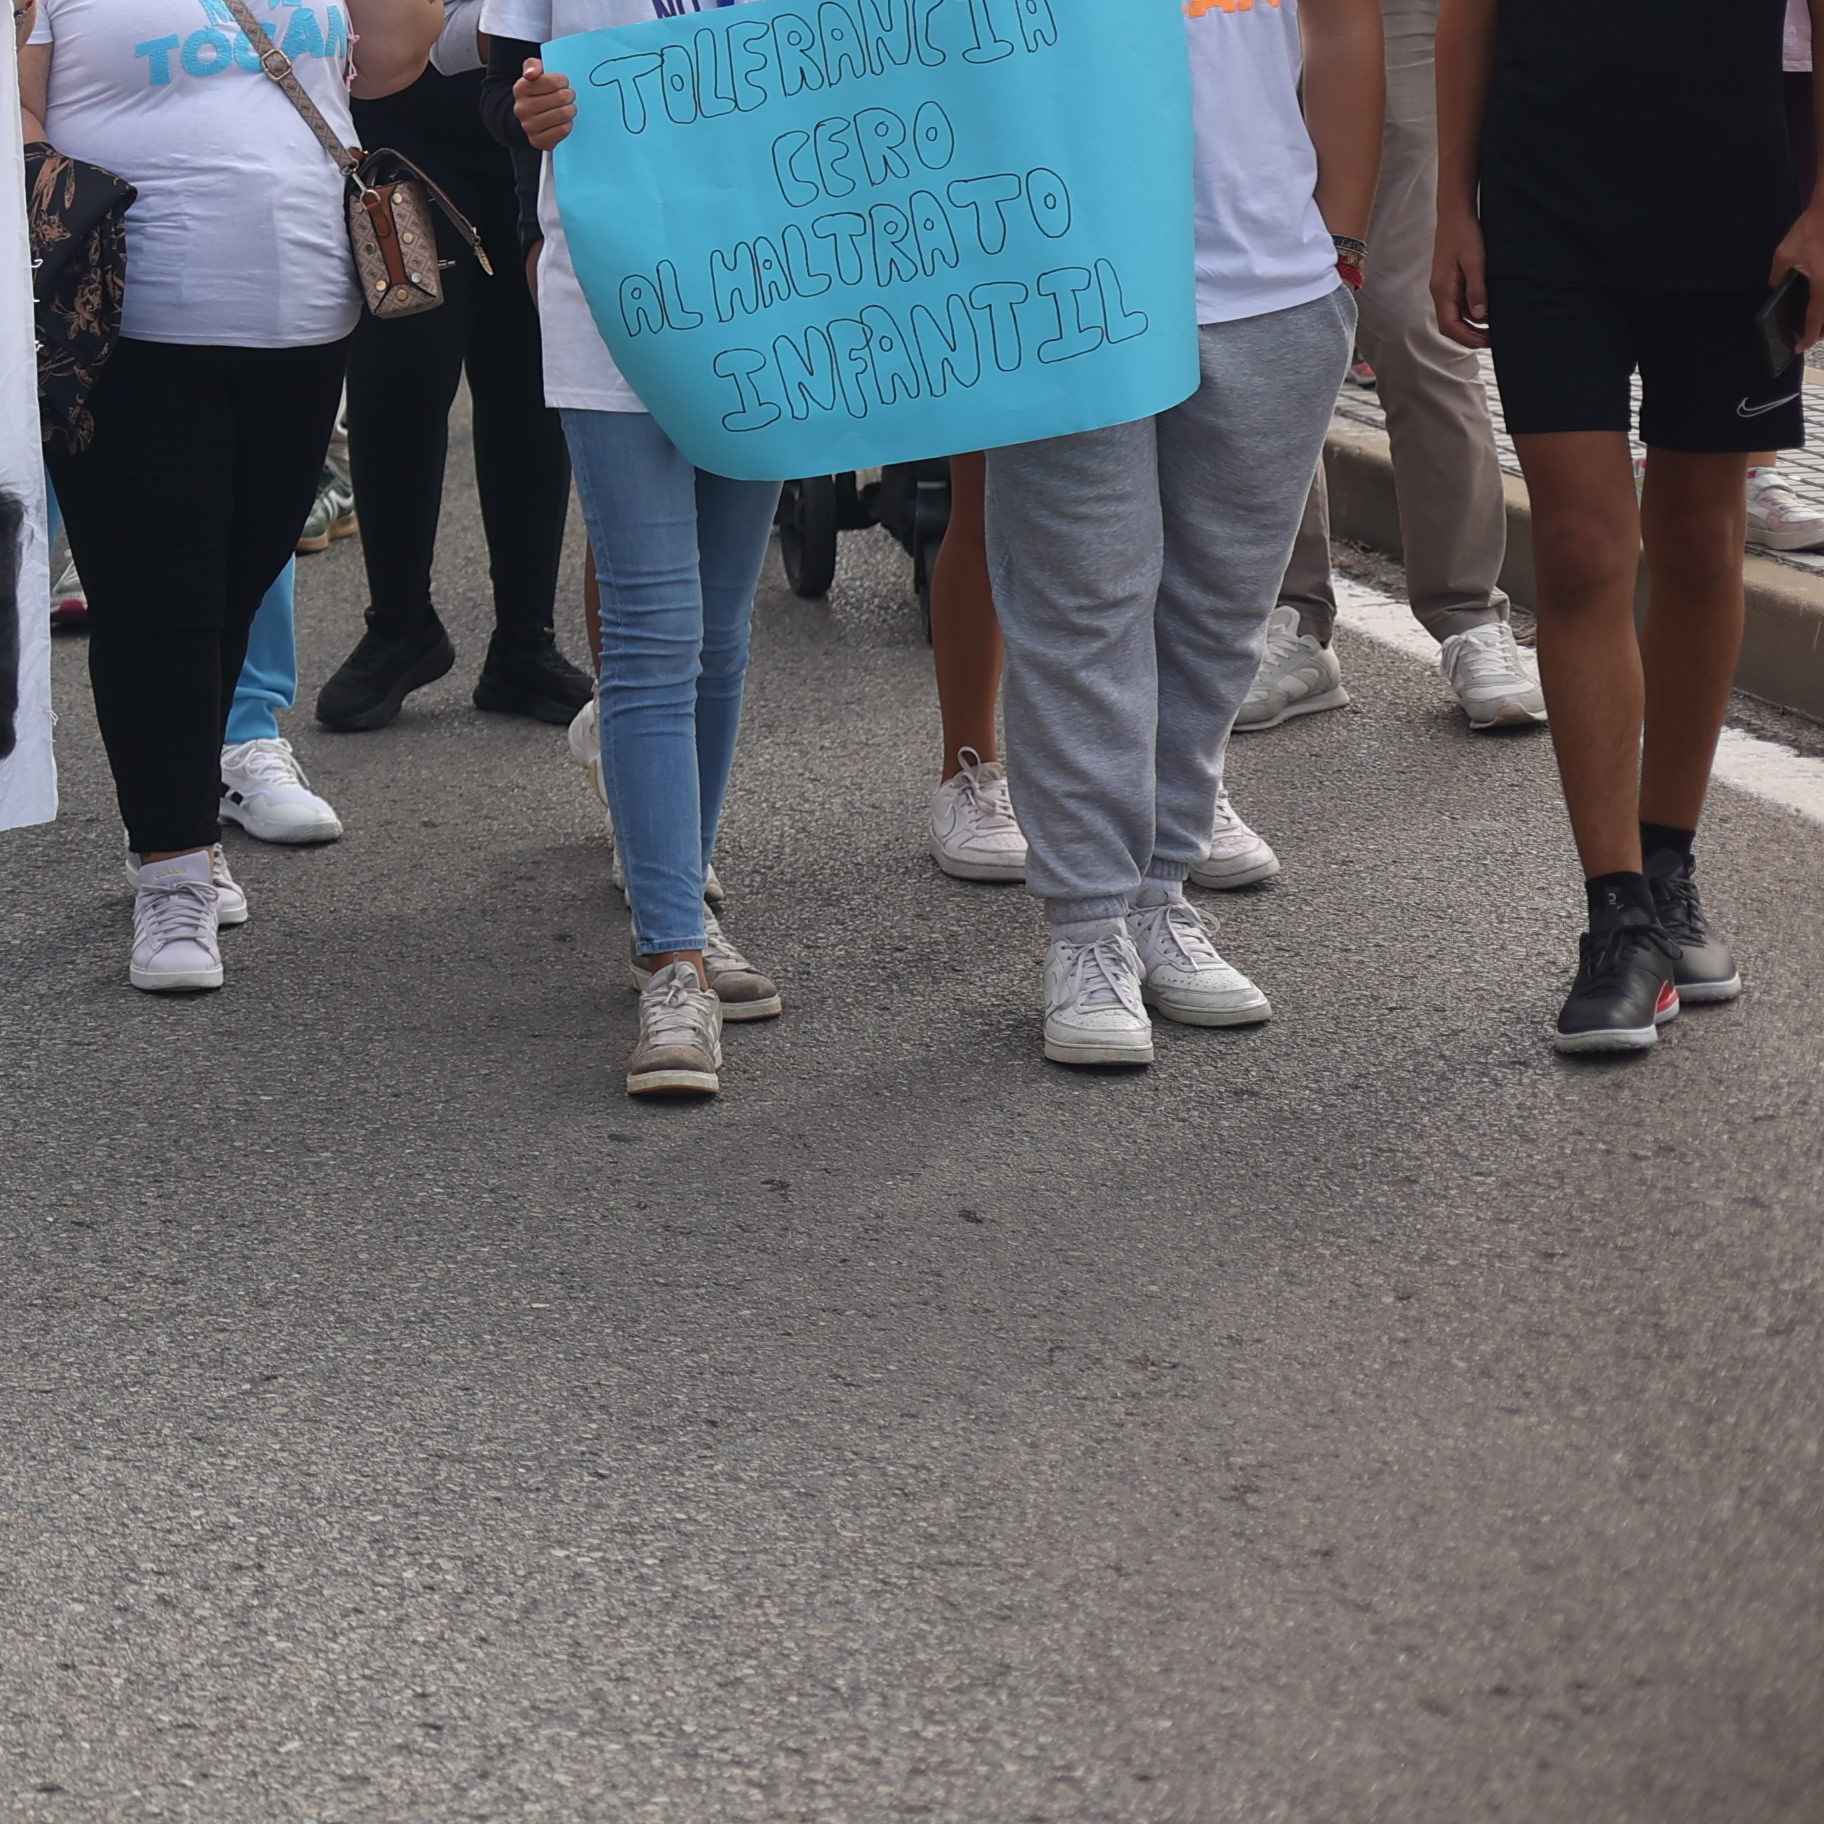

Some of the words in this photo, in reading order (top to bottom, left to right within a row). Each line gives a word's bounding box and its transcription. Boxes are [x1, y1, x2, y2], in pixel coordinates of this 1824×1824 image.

[771, 101, 955, 209] CERO
[619, 259, 703, 338] AL
[709, 166, 1072, 323] MALTRATO
[712, 257, 1149, 433] INFANTIL
